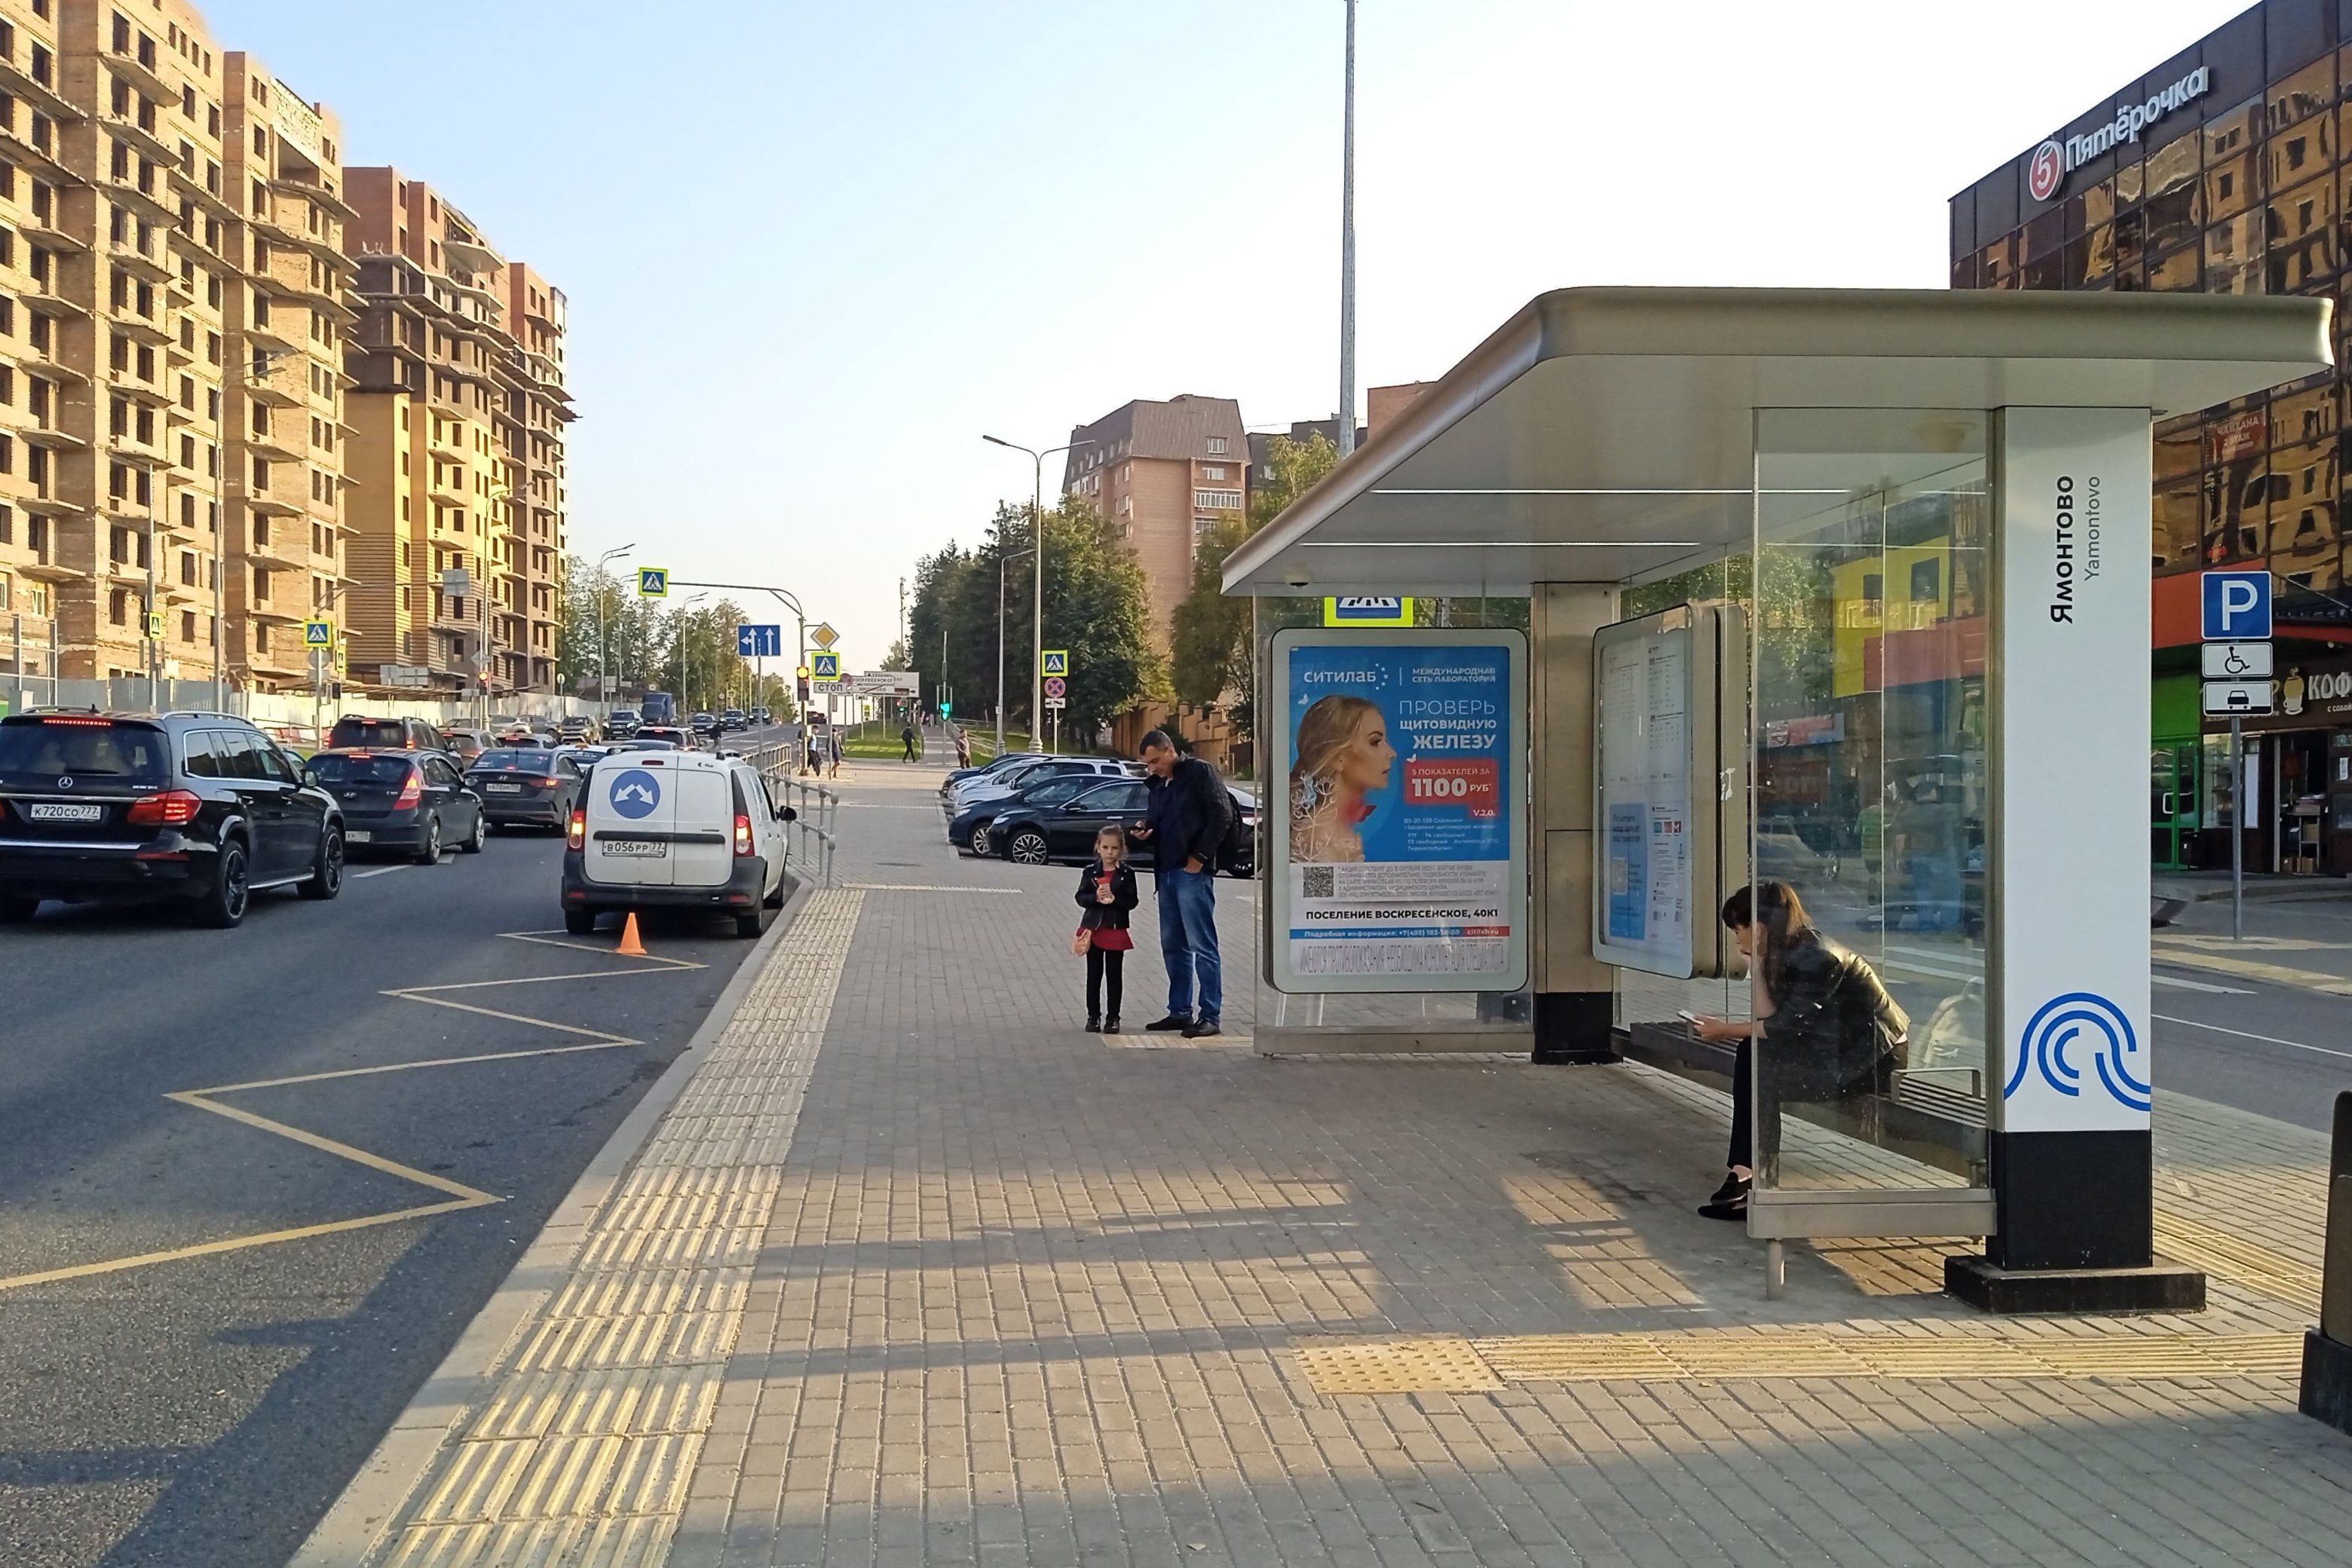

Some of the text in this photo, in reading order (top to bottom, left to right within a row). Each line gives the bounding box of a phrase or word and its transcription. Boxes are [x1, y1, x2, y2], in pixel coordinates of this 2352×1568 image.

[2065, 66, 2210, 173] Пятёрочка
[2084, 476, 2100, 581] Yamontovo
[1434, 675, 1496, 683] ЛАБОРАТОРИЙ
[818, 684, 843, 692] СТОП
[1400, 700, 1496, 715] ПРОВЕРЬ
[1400, 720, 1497, 731] ЩИТОВИДНУЮ
[1413, 734, 1496, 749] ЖЕЛЕЗУ
[1418, 767, 1478, 776] ПОКАЗАТЕЛЕЙ
[1412, 778, 1468, 797] 1100
[81, 805, 98, 816] 777
[607, 842, 663, 853] В056РР 77
[1306, 908, 1499, 920] ПОСЕЛЕНИЕ ВОСКРЕСЕНСКОЕ, 40К1
